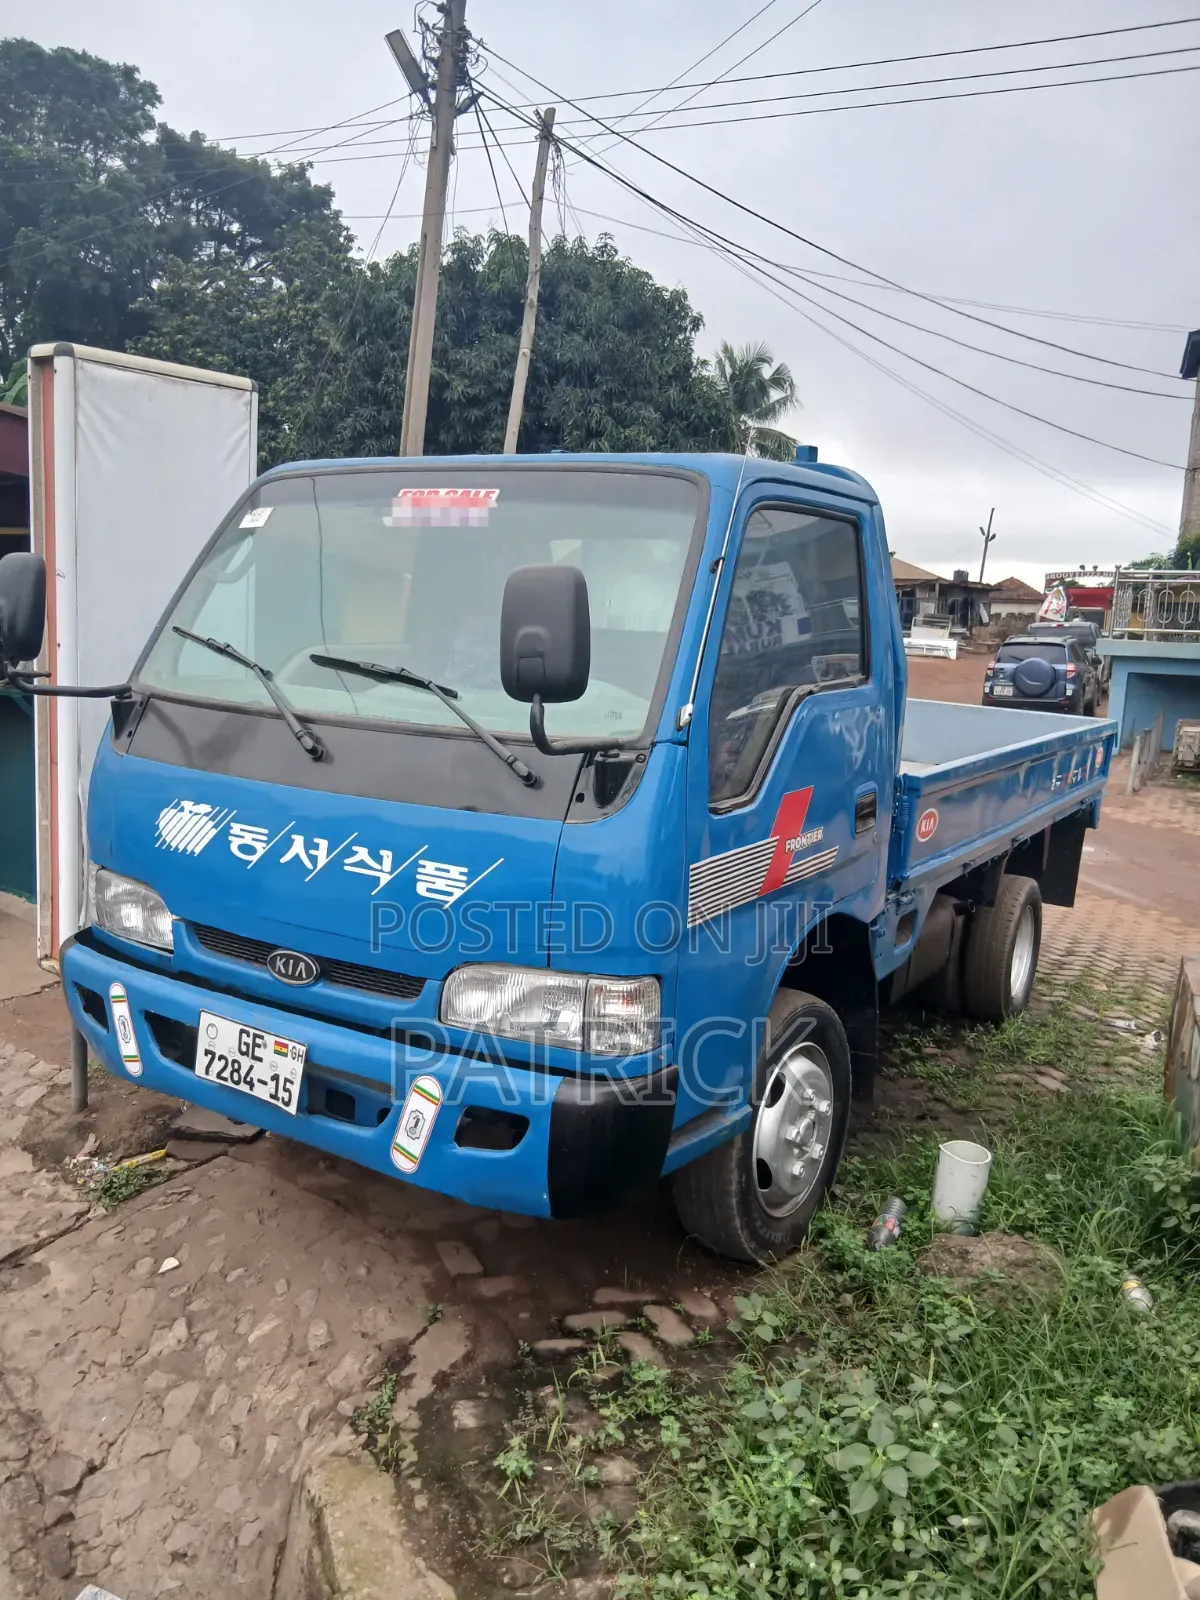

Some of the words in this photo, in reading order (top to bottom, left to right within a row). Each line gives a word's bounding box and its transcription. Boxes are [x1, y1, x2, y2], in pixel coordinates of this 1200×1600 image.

[919, 817, 935, 834] KIA
[785, 827, 824, 854] FRONTIER
[275, 956, 307, 980] KIA
[238, 1028, 264, 1063] GE
[290, 1045, 304, 1064] GH
[204, 1048, 294, 1107] 7284-15
